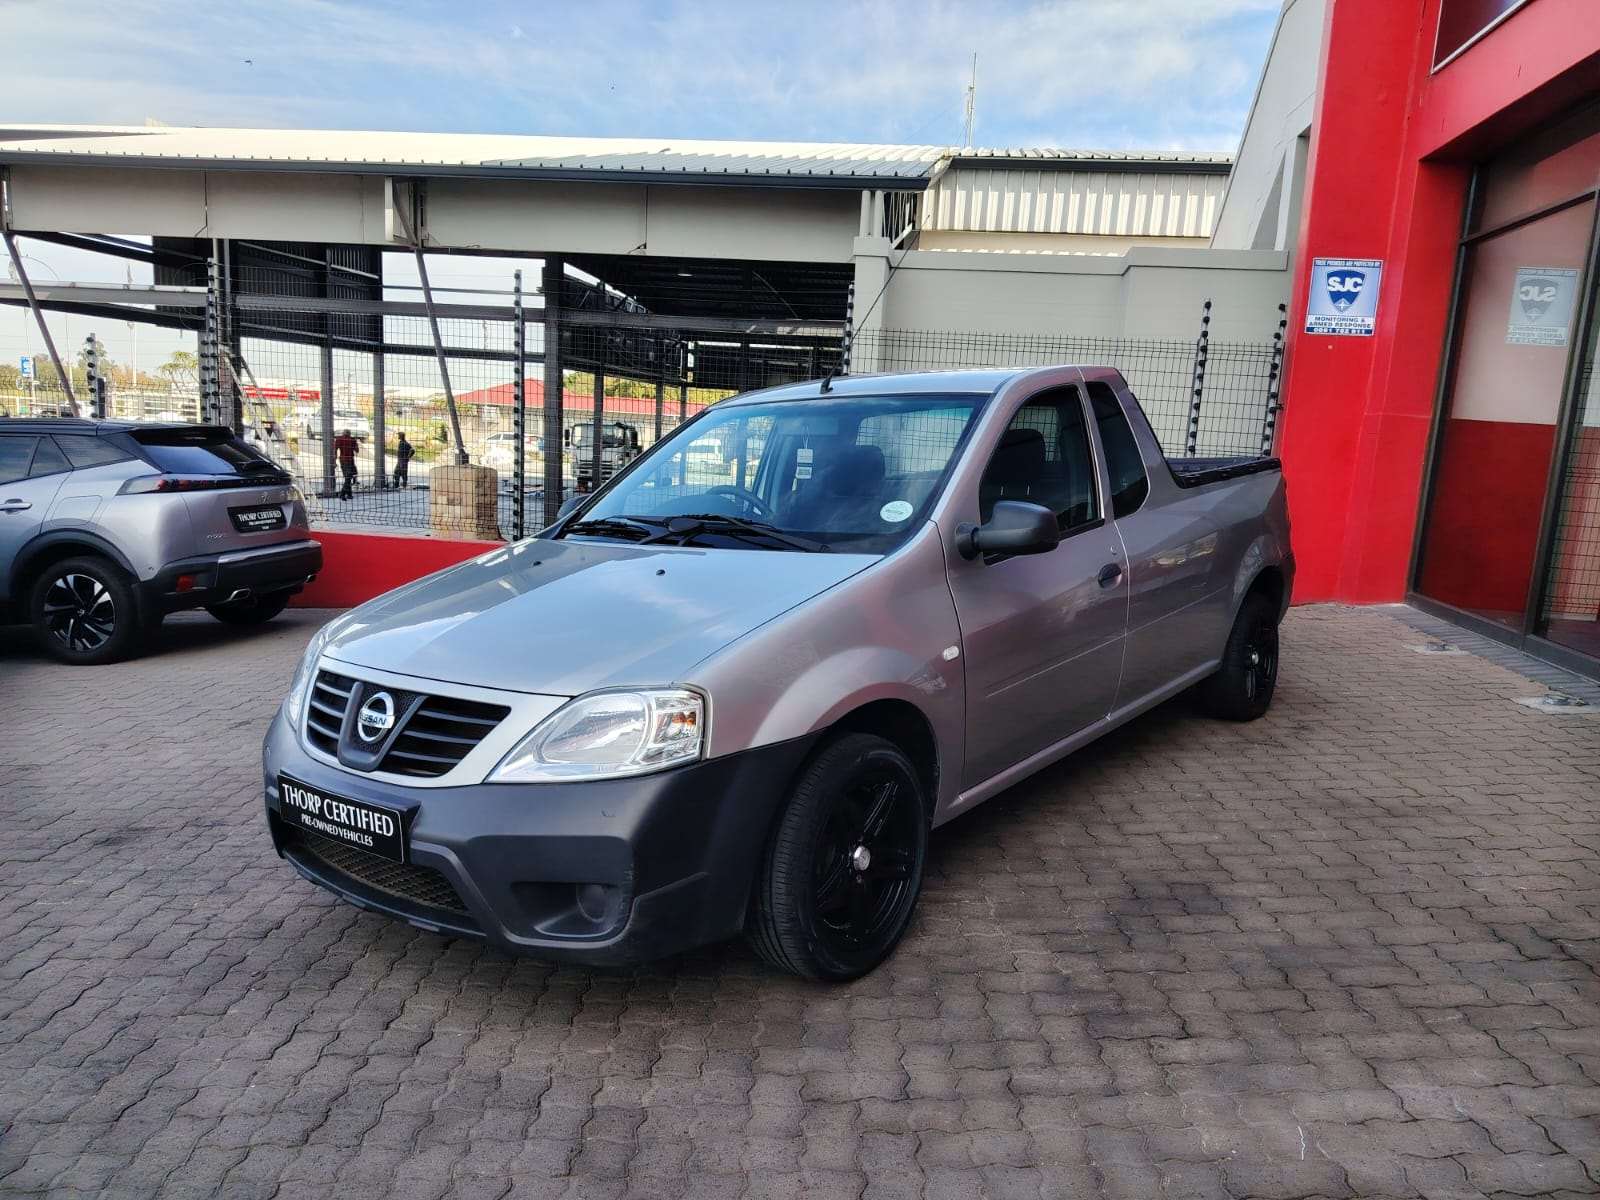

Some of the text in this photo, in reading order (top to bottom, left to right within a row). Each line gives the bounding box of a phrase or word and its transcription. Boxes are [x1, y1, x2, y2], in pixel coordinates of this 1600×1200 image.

[1328, 276, 1363, 293] SJC
[282, 783, 394, 838] THORP CERTIFIED
[301, 813, 374, 847] PRE-OWNED VEHICLES
